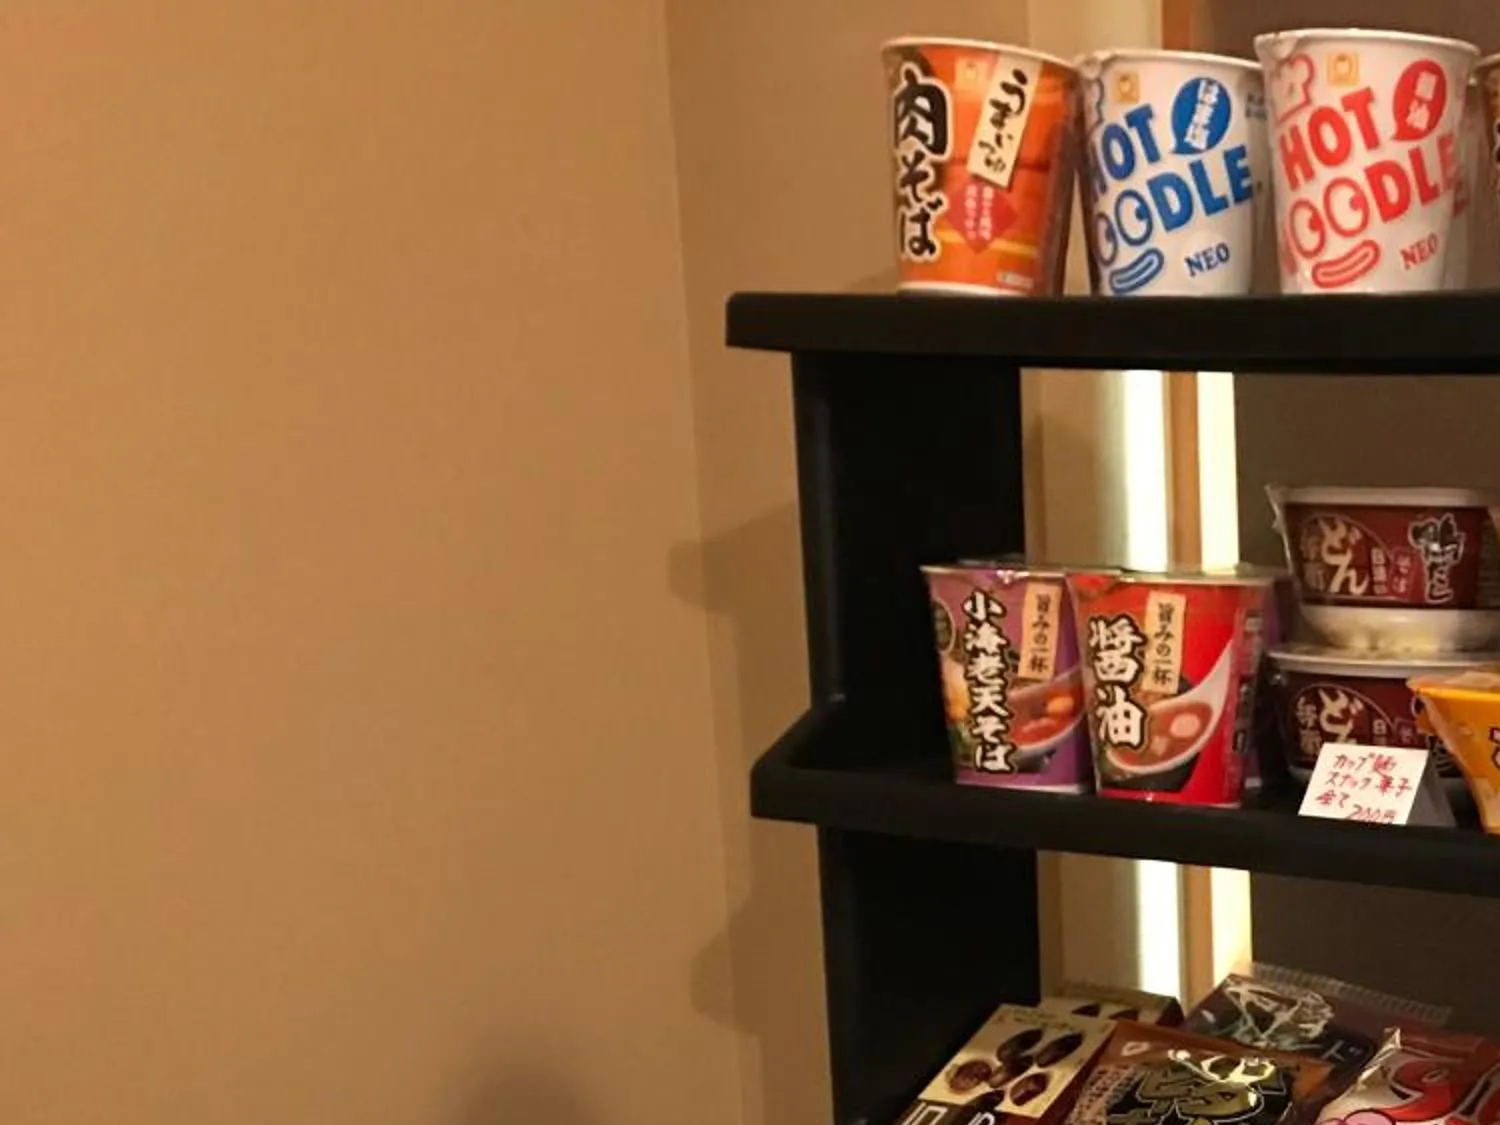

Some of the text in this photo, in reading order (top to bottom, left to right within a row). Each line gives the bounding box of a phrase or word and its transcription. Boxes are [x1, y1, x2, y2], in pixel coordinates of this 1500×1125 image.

[1099, 104, 1161, 196] OT
[1279, 87, 1381, 192] HOT
[1095, 144, 1254, 269] OODLE
[1399, 233, 1439, 271] NEO
[1184, 242, 1231, 277] NEO
[1087, 615, 1147, 748] 醤油
